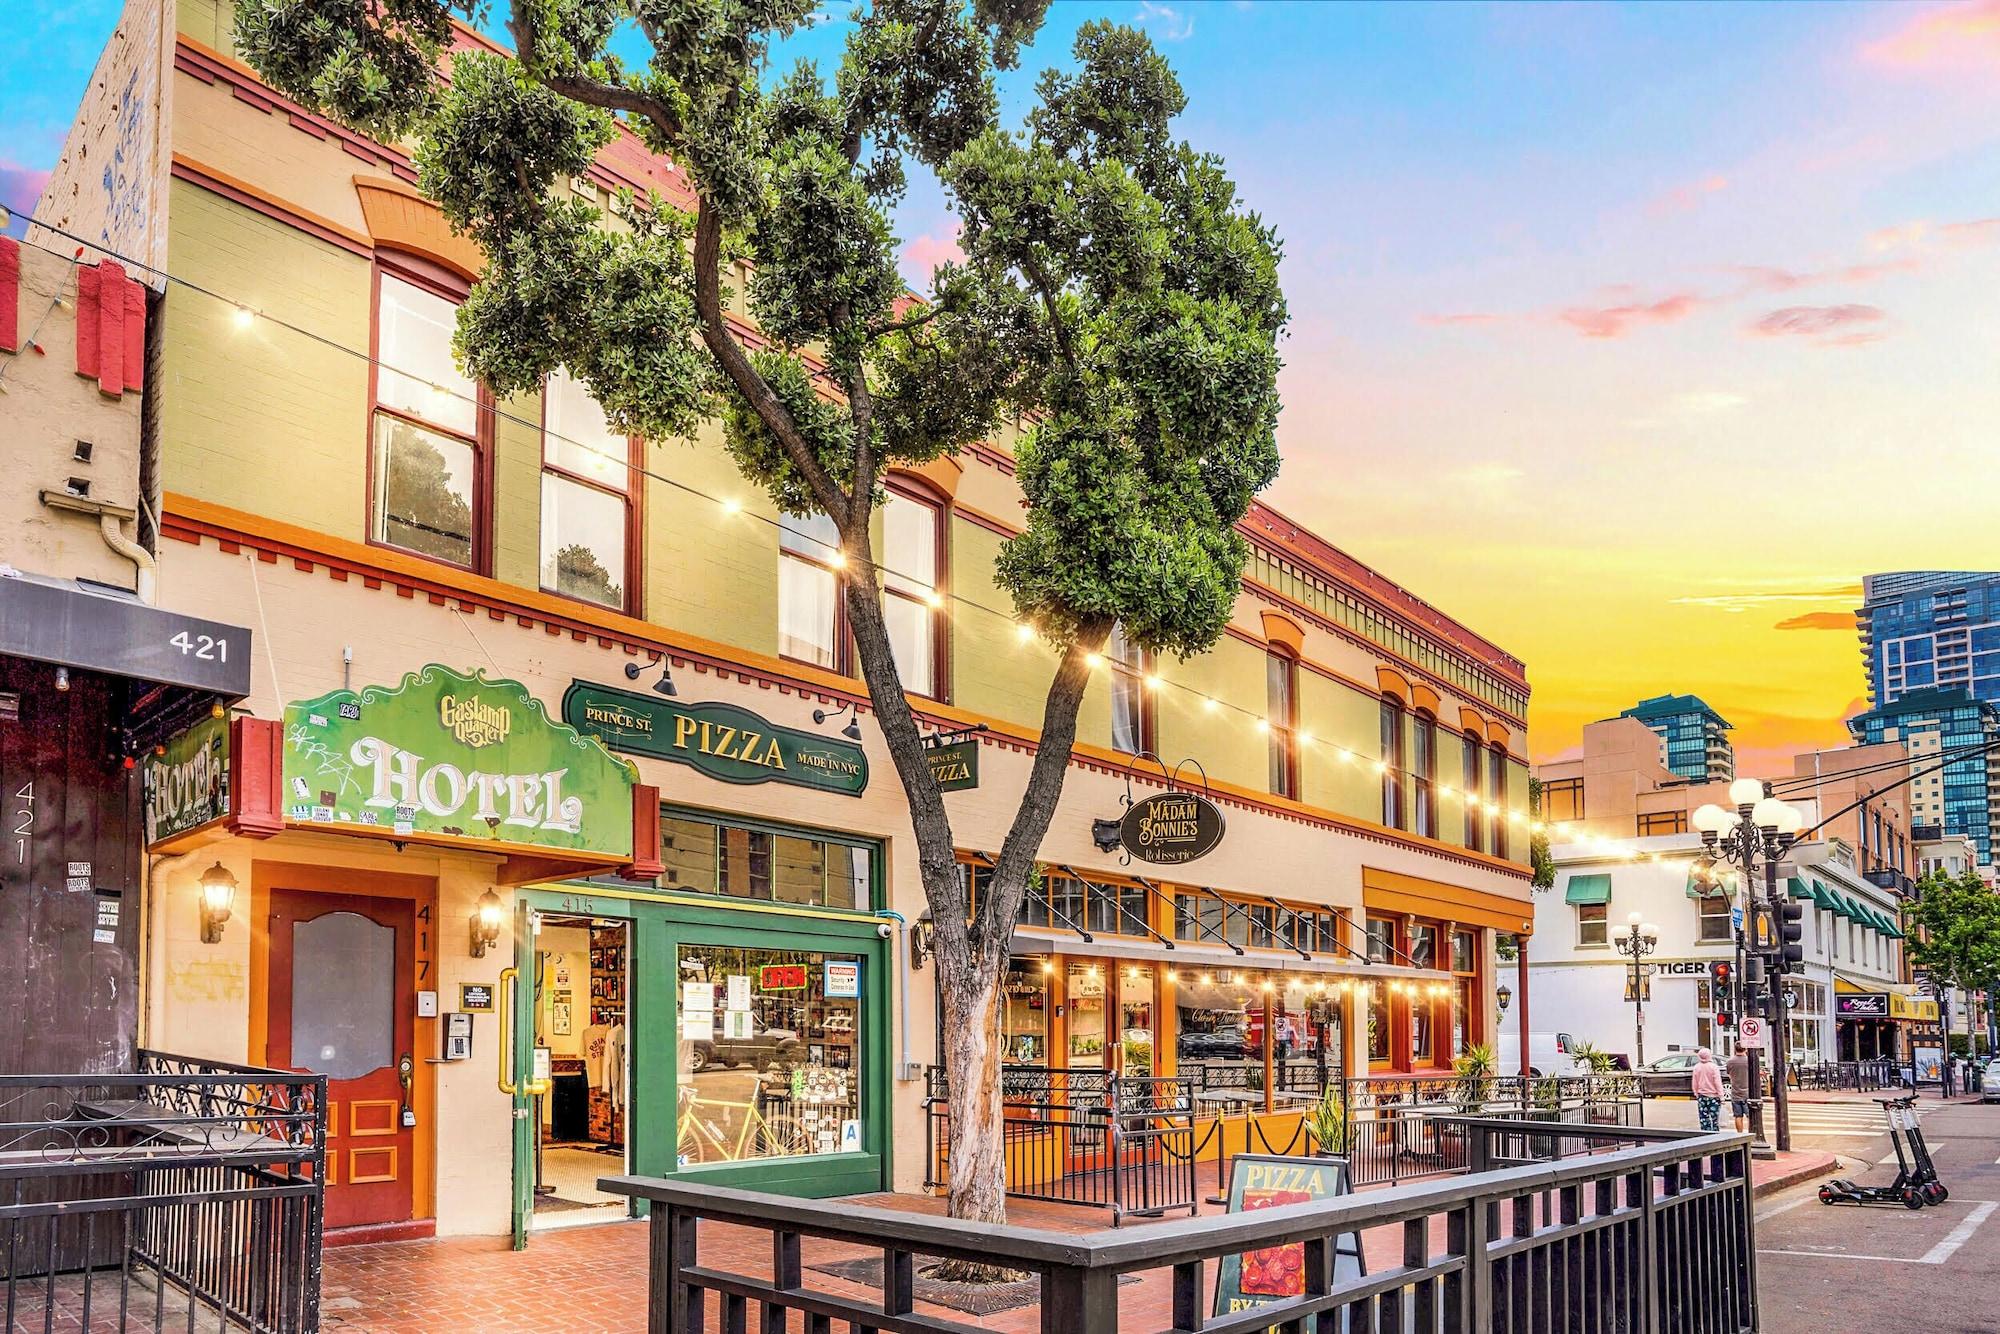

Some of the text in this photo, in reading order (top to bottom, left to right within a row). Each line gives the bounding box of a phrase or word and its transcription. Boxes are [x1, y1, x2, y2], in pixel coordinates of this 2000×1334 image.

[169, 631, 227, 663] 421
[440, 694, 511, 743] Gaslamp
[586, 707, 653, 732] PRINCE ST.
[672, 713, 787, 771] PIZZA
[796, 752, 861, 776] MADE IN NYC
[927, 752, 963, 764] PRINCE ST.
[350, 736, 583, 834] HOTEL
[396, 806, 415, 818] ROOTS
[1146, 800, 1198, 821] MADAM
[13, 781, 36, 864] 421
[1138, 817, 1199, 846] BONNIE'S
[1145, 848, 1195, 861] Rotisserie
[69, 863, 90, 872] ROOTS
[68, 878, 89, 888] ROOTS
[561, 896, 594, 914] 415
[416, 904, 430, 981] 417
[829, 967, 857, 975] WARNING
[1658, 962, 1705, 974] TIGER
[846, 1124, 856, 1140] A
[1246, 1165, 1324, 1194] PIZZA
[1229, 1298, 1253, 1313] BY
